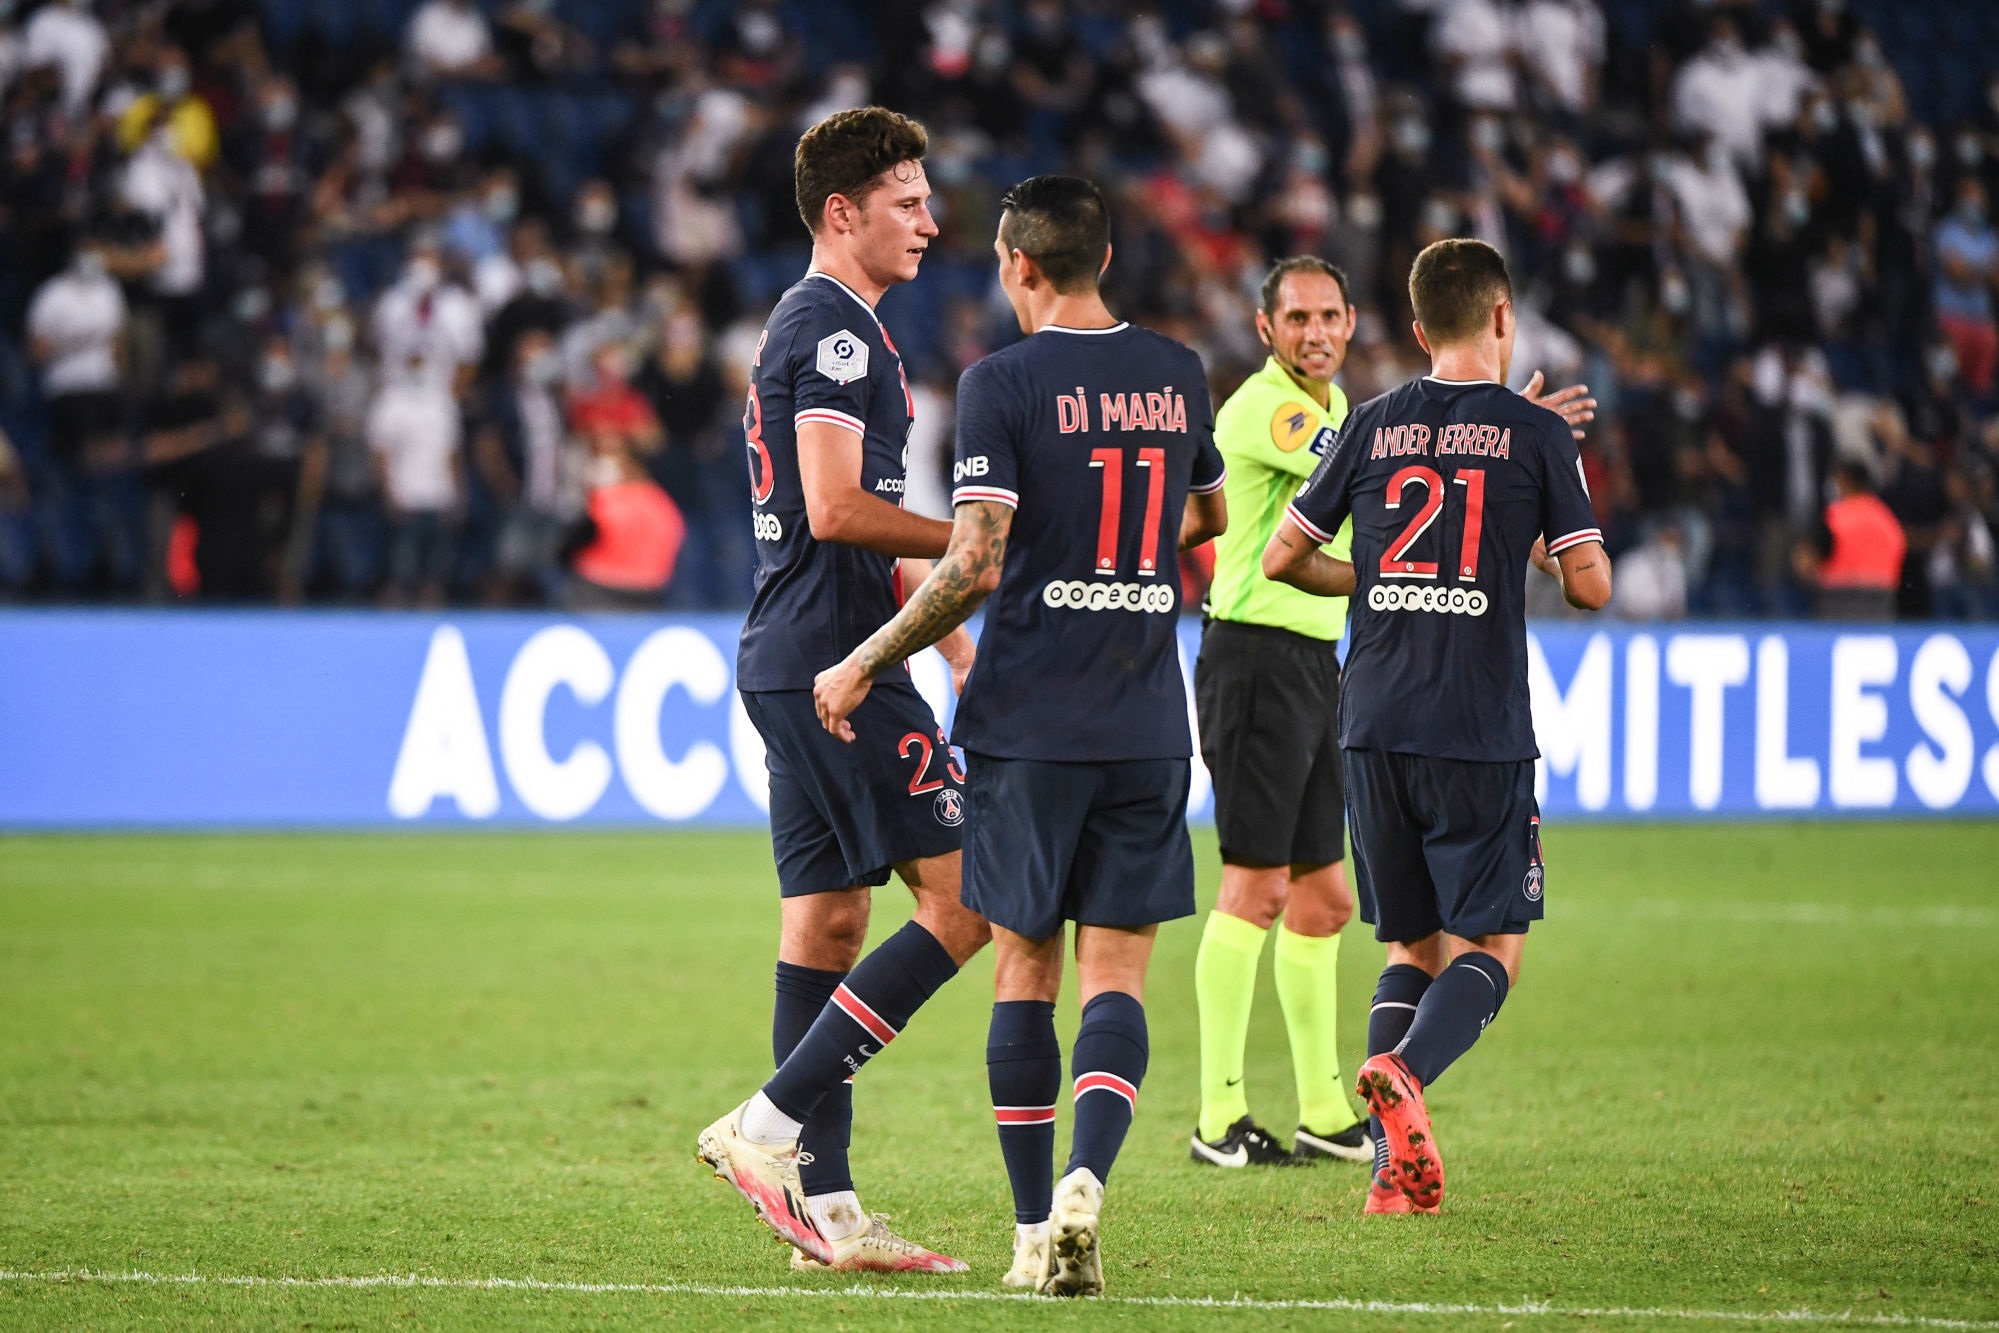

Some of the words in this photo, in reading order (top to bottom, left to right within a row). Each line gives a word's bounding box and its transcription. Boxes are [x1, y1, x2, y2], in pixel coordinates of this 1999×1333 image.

[1100, 386, 1187, 434] MARÍA
[1371, 423, 1431, 460] ANDER
[1089, 447, 1166, 577] 11
[1379, 465, 1486, 582] 21
[1043, 580, 1175, 614] ooredoo
[1368, 584, 1489, 617] ooredoo
[1526, 632, 1999, 812] MITLES
